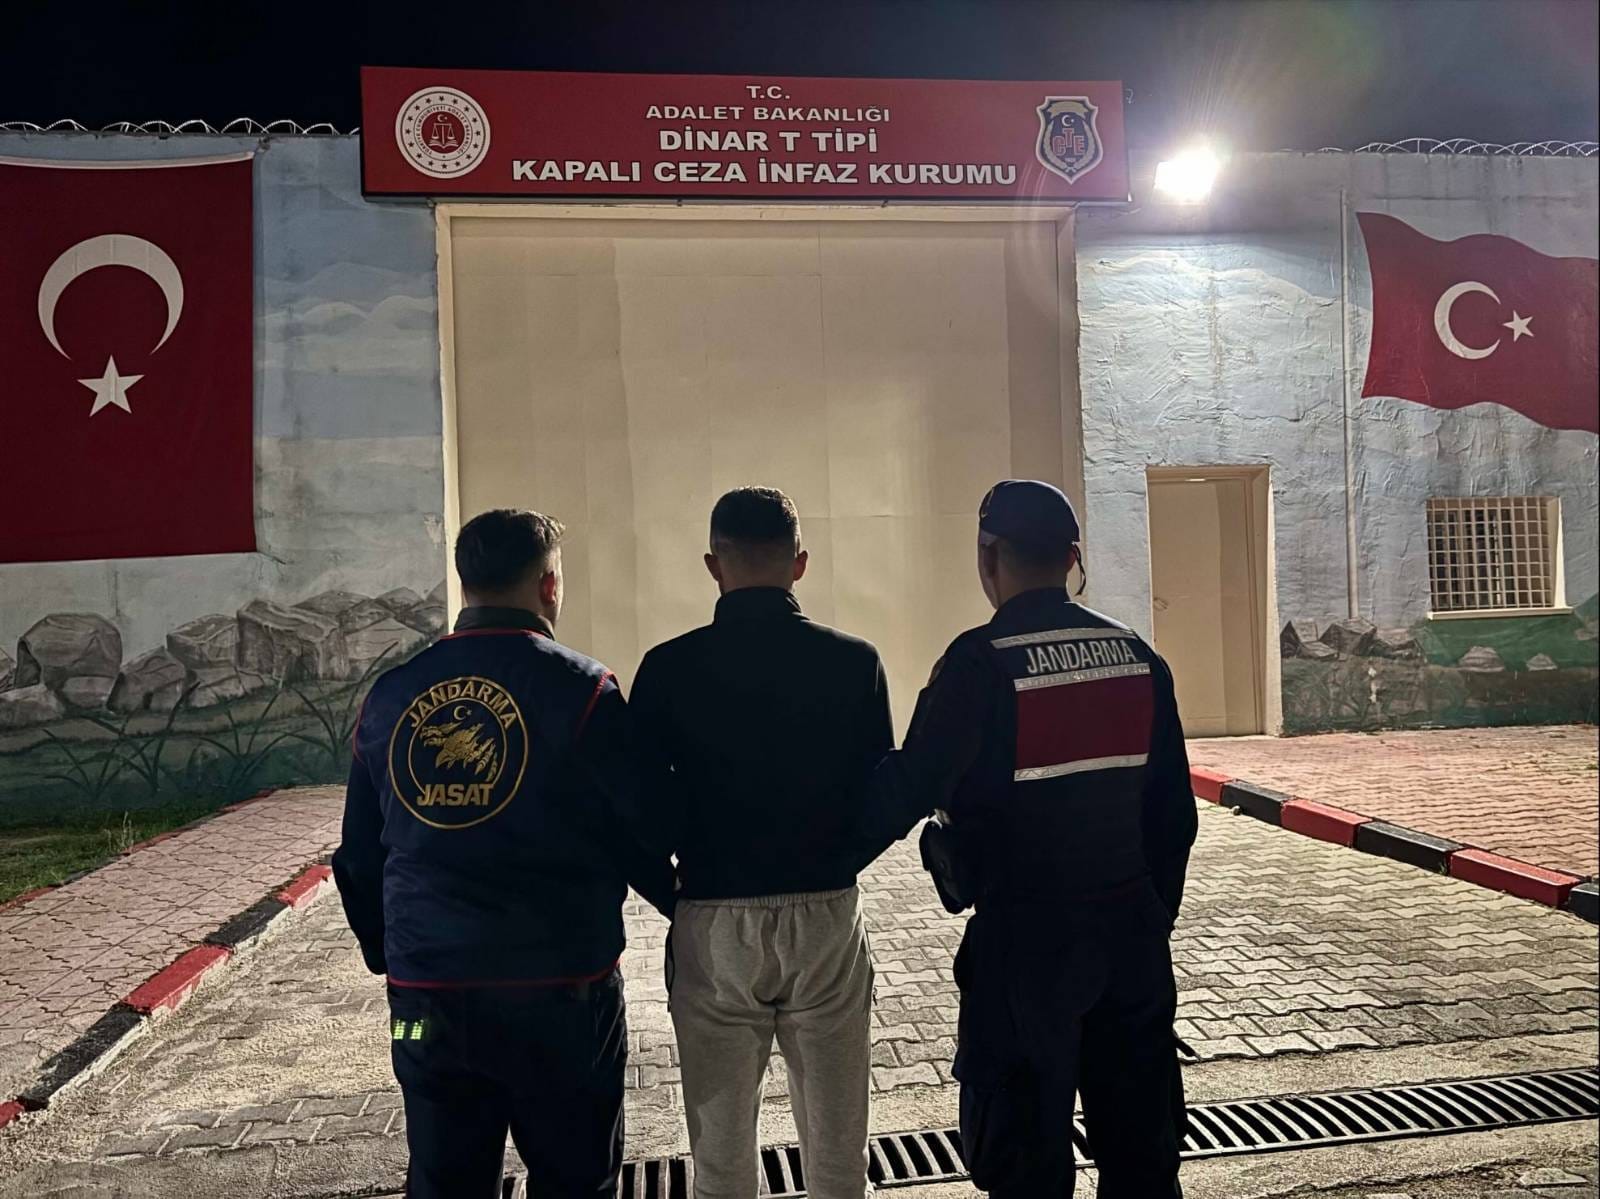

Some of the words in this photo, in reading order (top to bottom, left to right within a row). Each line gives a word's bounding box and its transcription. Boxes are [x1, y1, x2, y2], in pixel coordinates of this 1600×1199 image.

[746, 85, 791, 99] T.C.
[646, 106, 745, 120] ADALET
[754, 106, 890, 121] BAKANLIĞI
[659, 126, 769, 151] DİNAR
[779, 132, 801, 151] T
[811, 128, 878, 153] TİPİ
[512, 160, 641, 182] KAPALI
[653, 162, 747, 182] CEZA
[758, 158, 858, 183] İNFAZ
[869, 164, 1017, 185] KURUMU
[1025, 639, 1137, 674] JANDARMA
[408, 681, 517, 730] JANDARMA
[416, 783, 495, 806] JASAT
